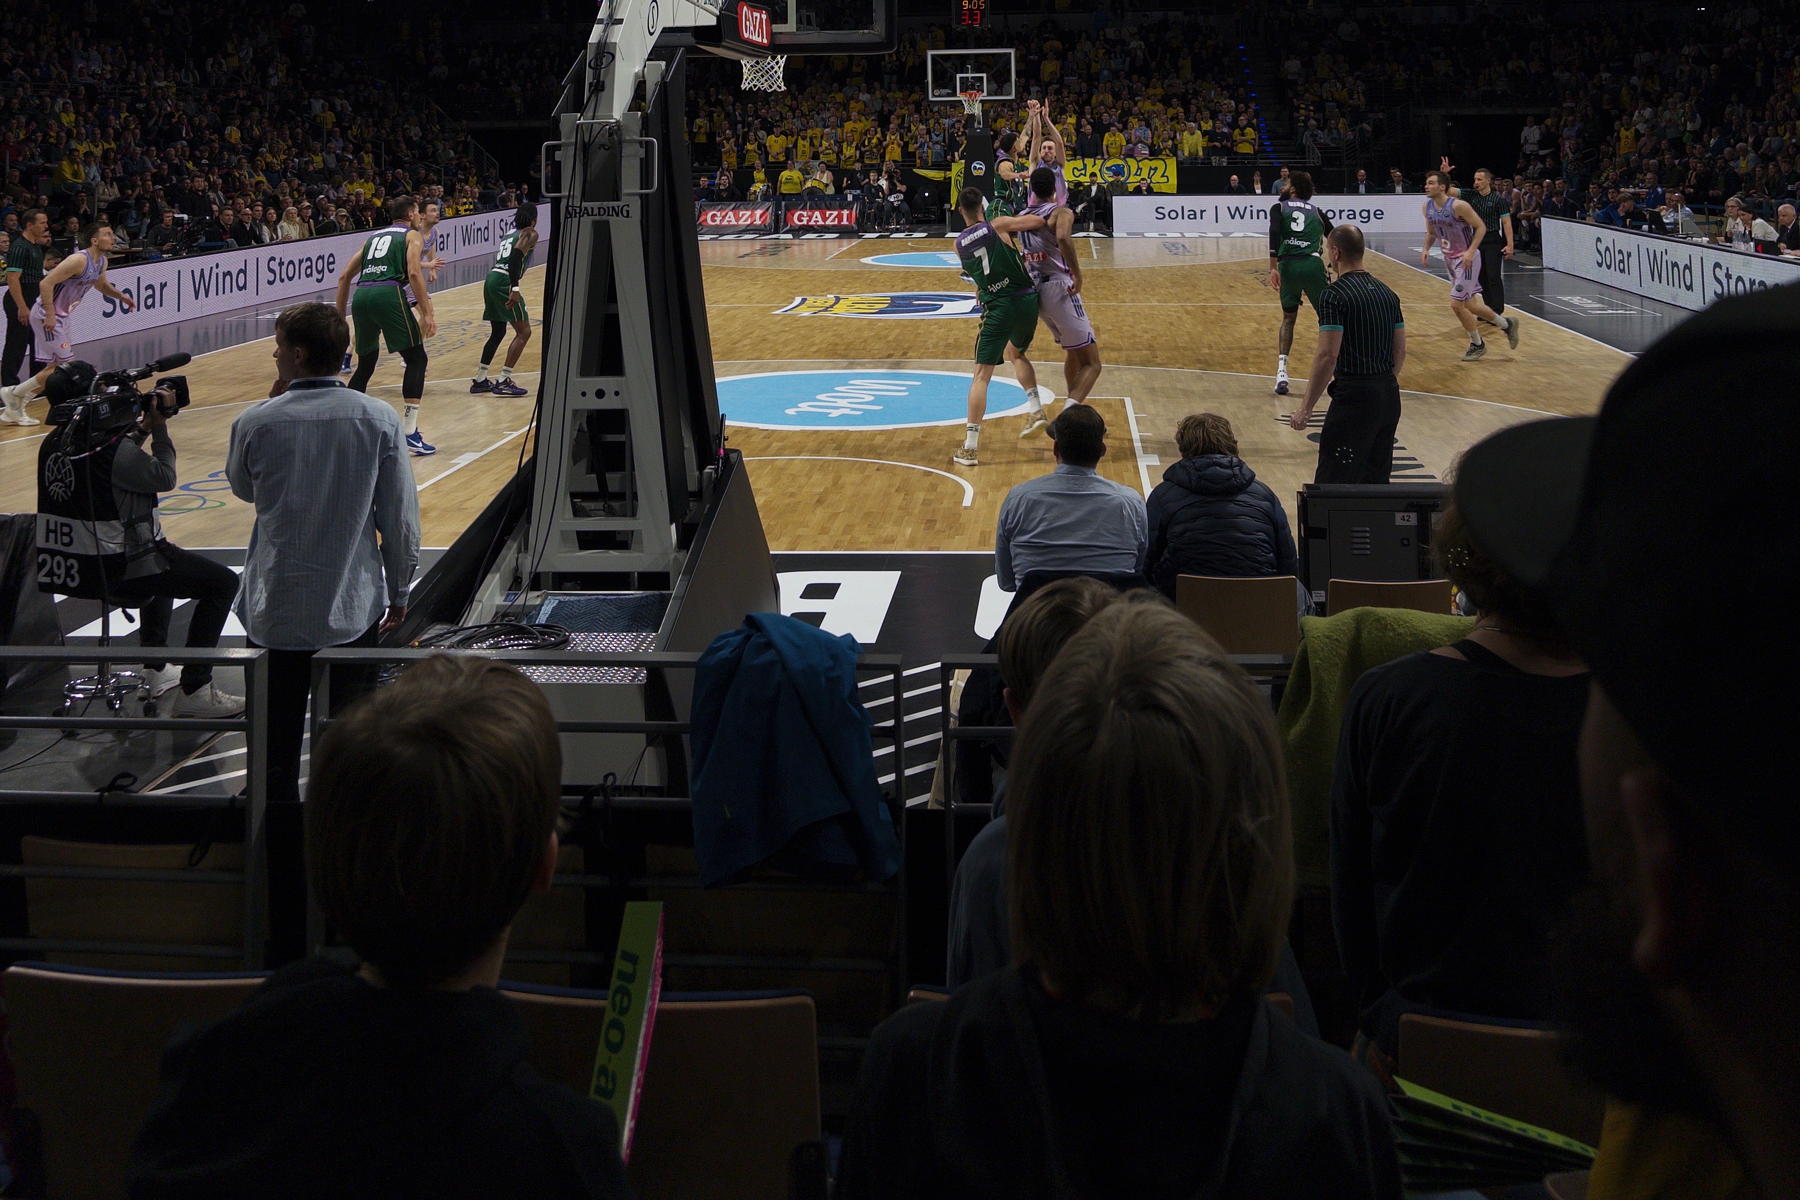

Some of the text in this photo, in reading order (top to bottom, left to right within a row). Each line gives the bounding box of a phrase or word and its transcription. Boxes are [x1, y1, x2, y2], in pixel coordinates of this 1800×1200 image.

[565, 204, 630, 219] SPALDING
[1155, 205, 1206, 220] Solar
[1227, 205, 1269, 220] Win
[1322, 206, 1385, 223] orage
[1290, 210, 1305, 232] 3
[461, 220, 490, 246] Wind
[367, 235, 392, 260] 19
[497, 237, 514, 260] 55
[973, 246, 990, 276] 7
[1595, 237, 1632, 275] Solar
[1647, 247, 1694, 292] Wind
[102, 276, 167, 318] Solar
[191, 259, 247, 300] Wind
[266, 252, 336, 285] Storage
[1400, 514, 1411, 522] 42
[45, 519, 74, 546] HB
[37, 553, 80, 588] 293
